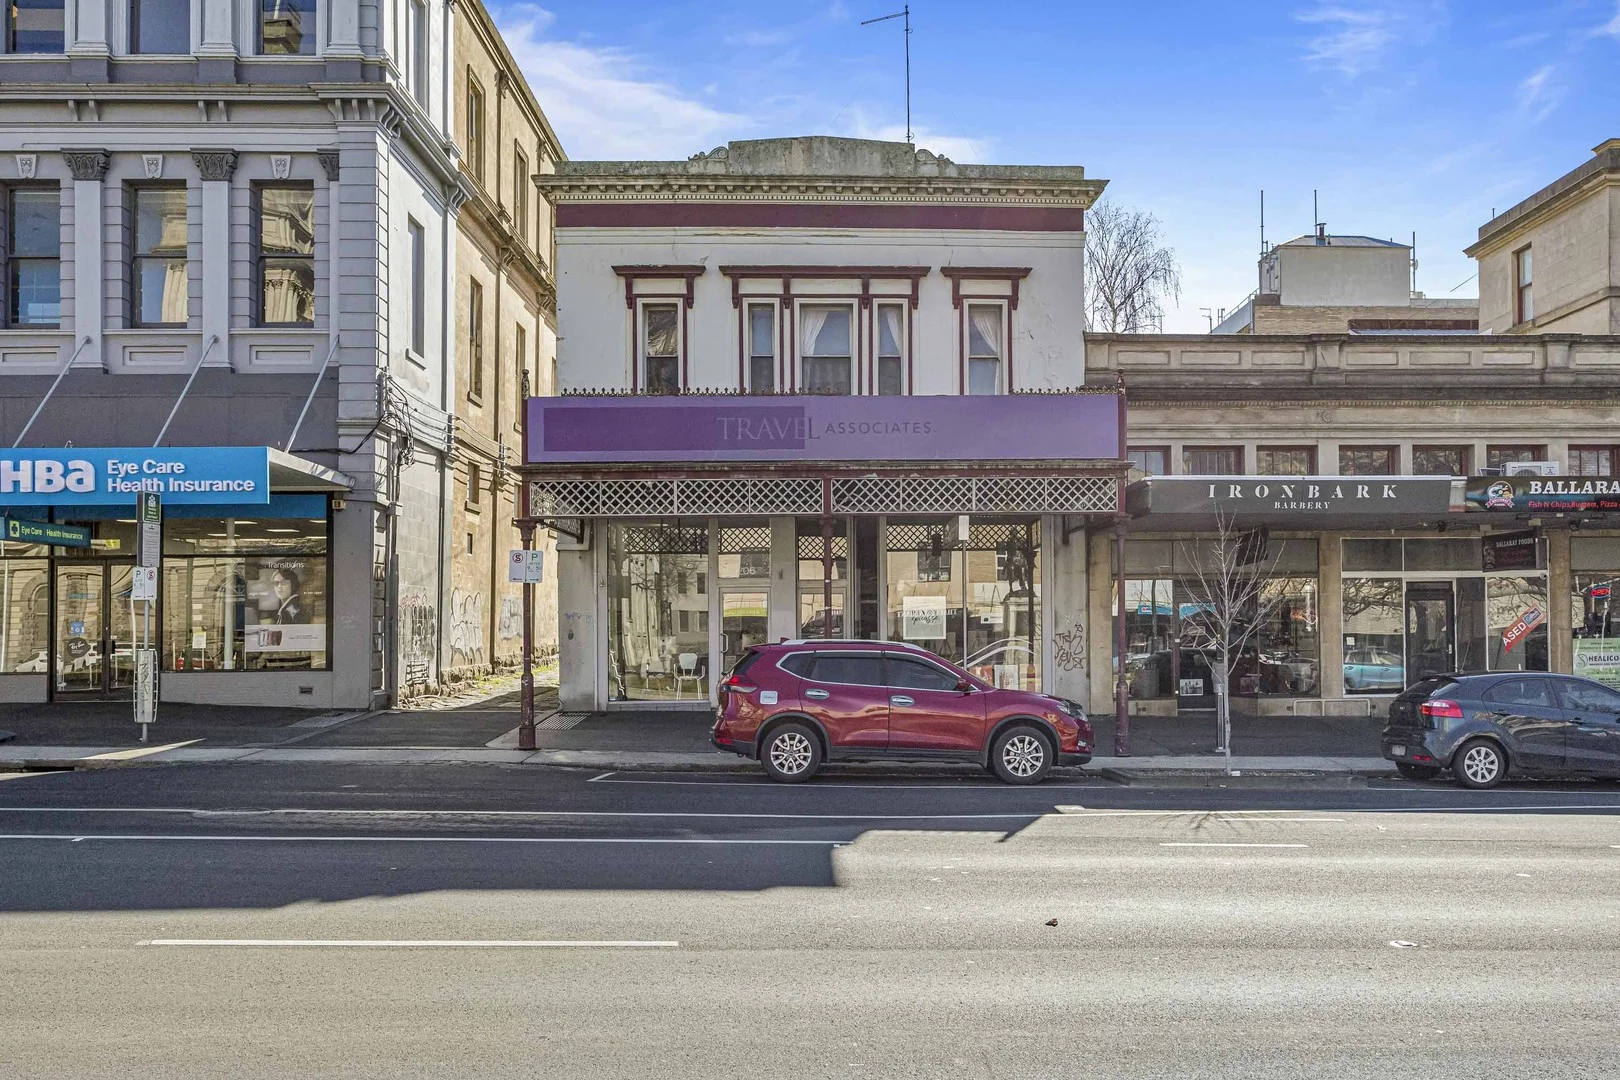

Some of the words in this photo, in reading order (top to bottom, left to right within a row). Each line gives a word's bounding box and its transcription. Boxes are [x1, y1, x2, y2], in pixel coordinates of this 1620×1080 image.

[716, 417, 820, 440] TRAVEL
[107, 460, 140, 477] Eye
[142, 459, 186, 475] Care
[107, 477, 165, 492] Health
[169, 477, 256, 492] Insurance
[1529, 481, 1620, 495] BALLARA
[1208, 484, 1397, 499] IRONBARK
[1274, 501, 1331, 510] BARBERY
[1600, 500, 1618, 508] Pizza
[21, 525, 31, 535] Eye
[31, 527, 43, 536] Care
[46, 529, 61, 538] Health
[62, 531, 83, 540] Insurance
[531, 553, 538, 561] P
[268, 561, 305, 569] Transitions
[136, 570, 142, 578] P
[1591, 587, 1610, 597] OPEN
